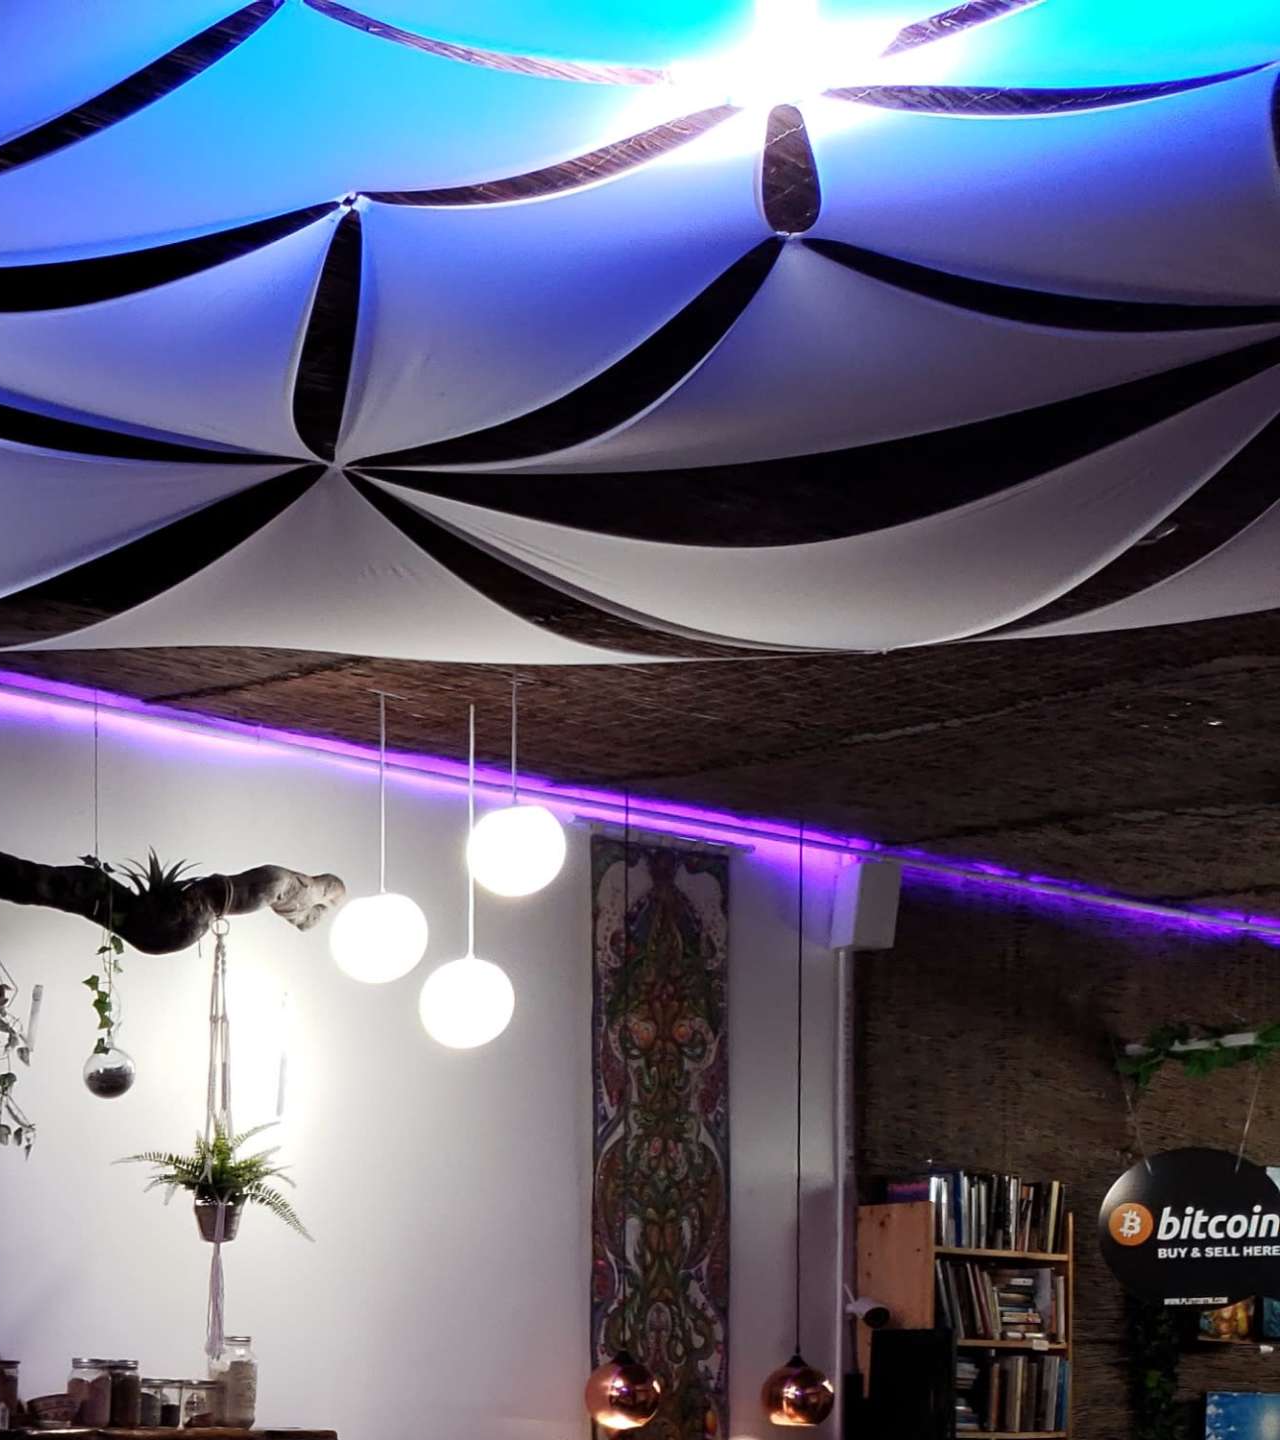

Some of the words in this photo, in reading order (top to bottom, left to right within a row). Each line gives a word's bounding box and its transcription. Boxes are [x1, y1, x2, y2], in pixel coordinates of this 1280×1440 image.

[1156, 1205, 1280, 1240] bitcoin
[1158, 1247, 1188, 1259] BUY
[1191, 1247, 1201, 1257] &
[1205, 1246, 1240, 1257] SELL
[1243, 1245, 1280, 1256] HERE
